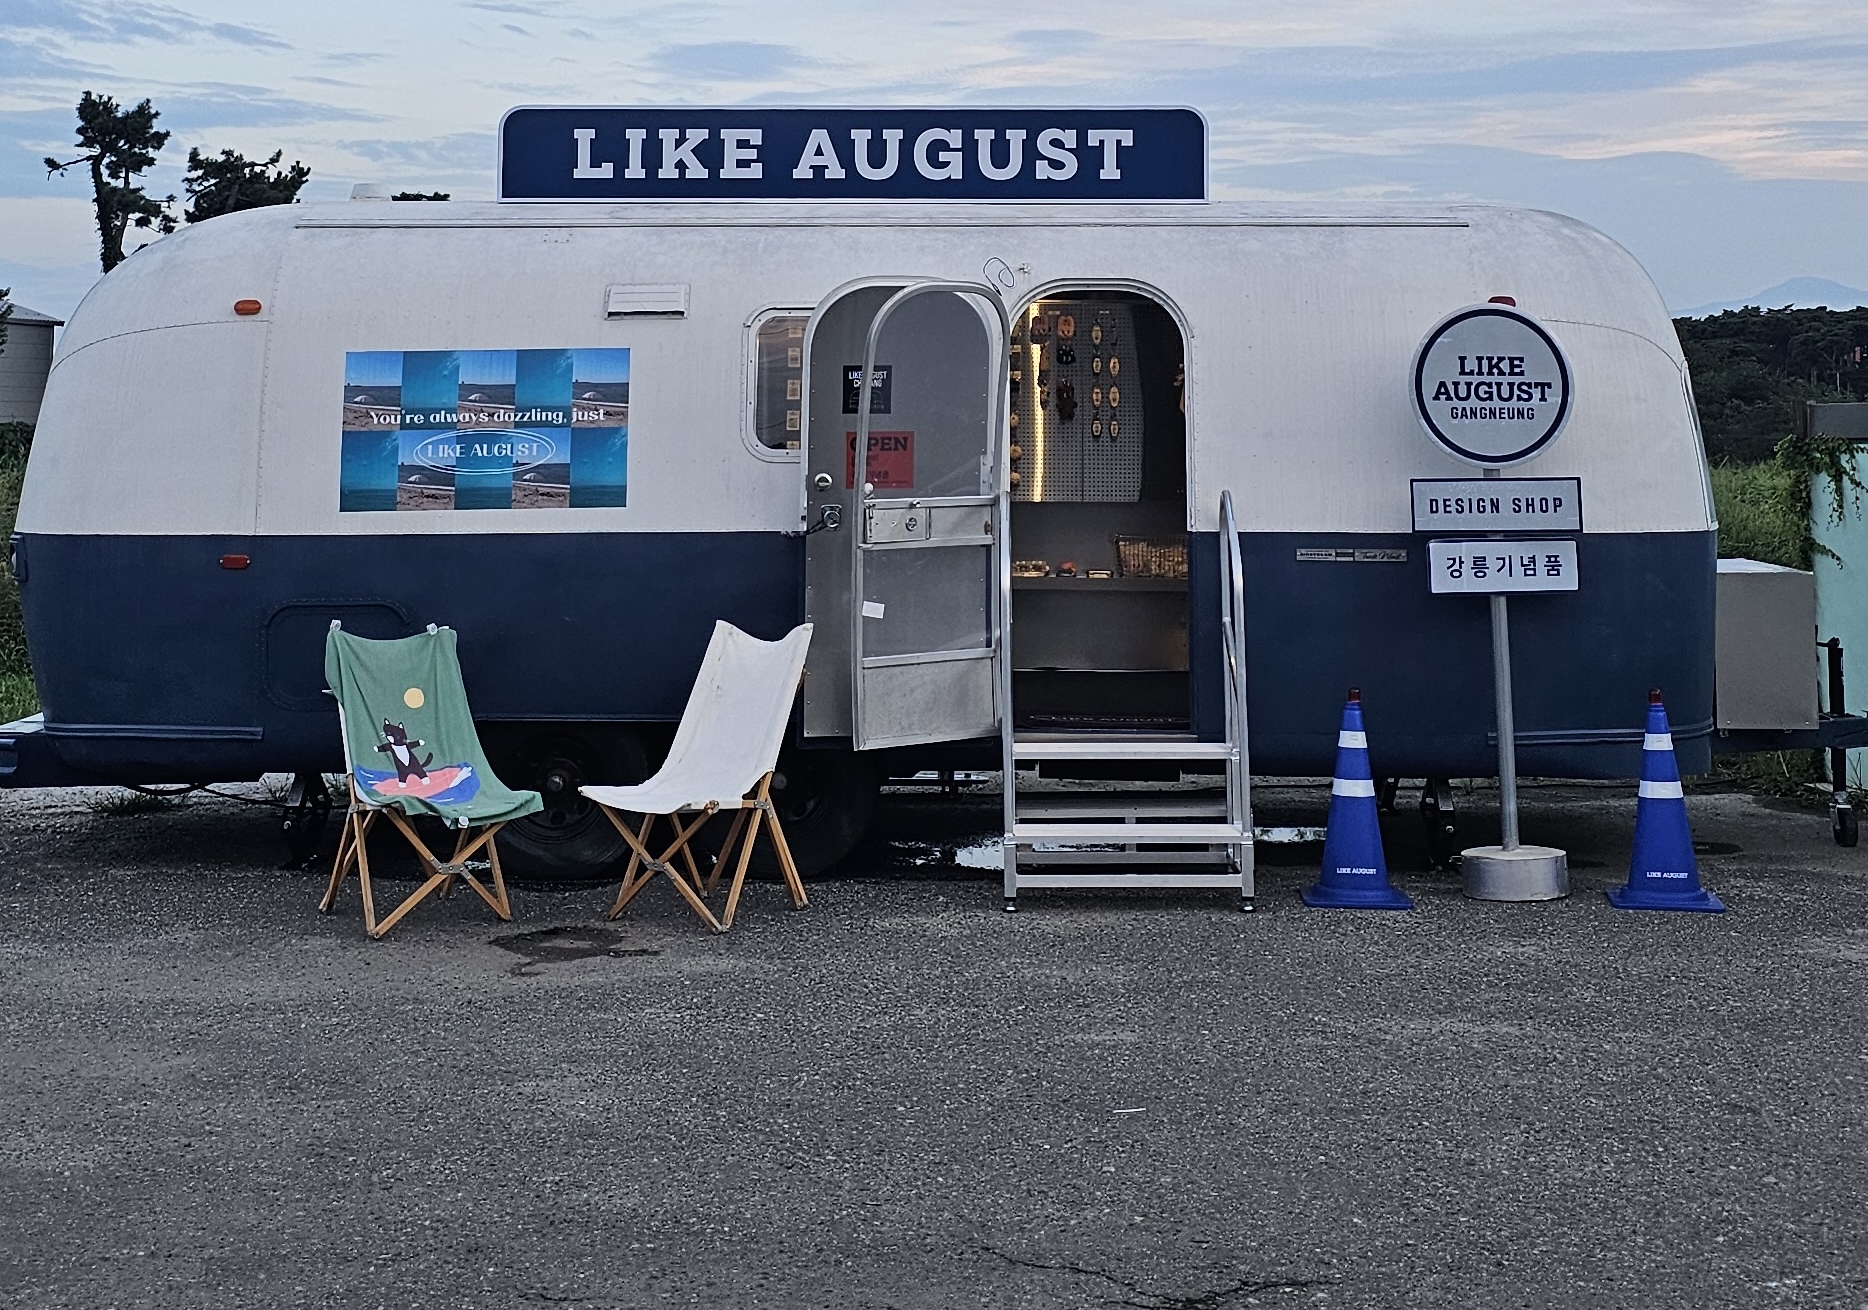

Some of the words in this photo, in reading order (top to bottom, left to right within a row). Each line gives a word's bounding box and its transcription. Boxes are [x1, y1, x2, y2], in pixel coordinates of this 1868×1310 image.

[573, 128, 763, 179] LIKE
[792, 127, 1134, 181] AUGUST
[1457, 355, 1525, 377] LIKE
[1432, 380, 1552, 403] AUGUST
[369, 409, 425, 426] You're
[429, 409, 489, 427] always
[493, 408, 568, 425] dazzling,
[571, 407, 606, 425] just
[1450, 406, 1535, 420] GANGNEUNG
[427, 443, 467, 458] LIKE
[469, 442, 541, 458] AUGUST
[1429, 497, 1500, 514] DESIGN
[1511, 496, 1563, 514] SHOP
[1446, 554, 1563, 579] 강릉기념품
